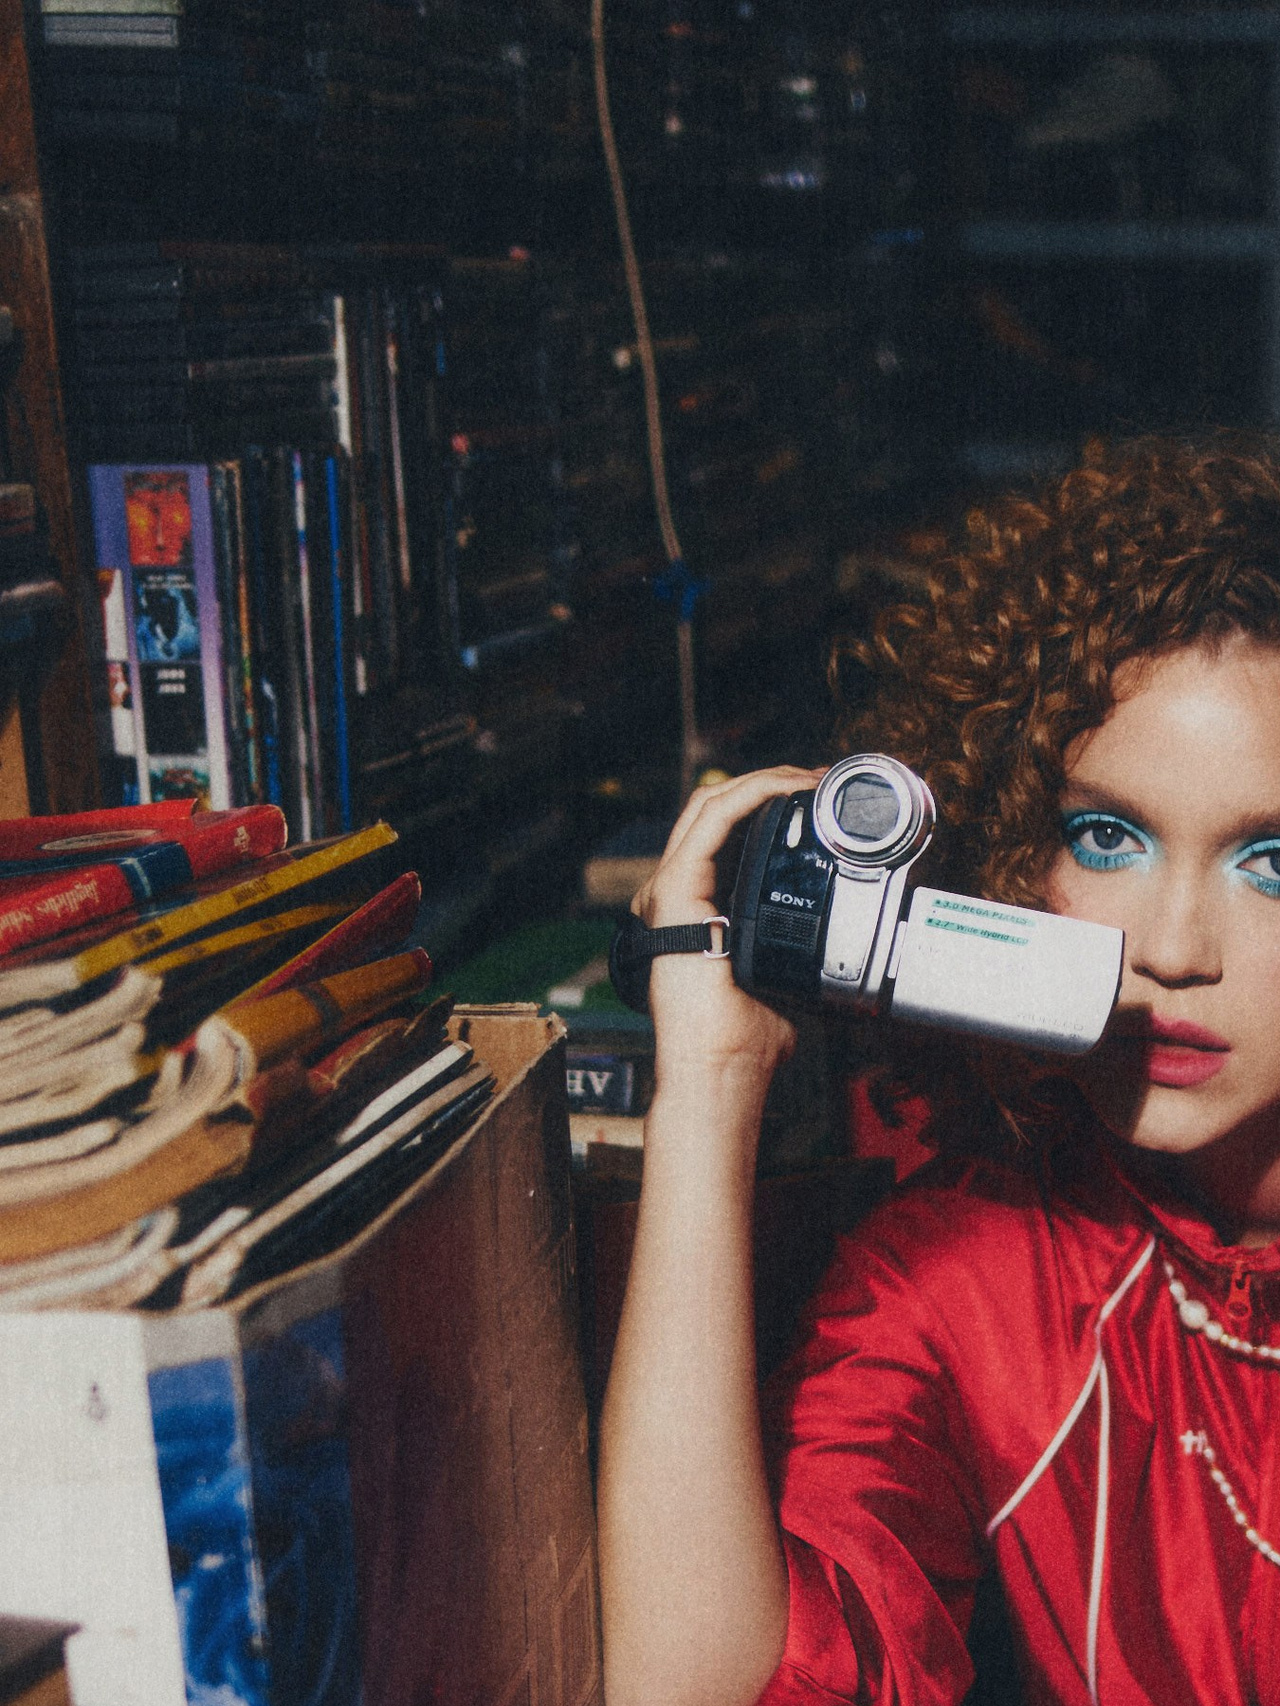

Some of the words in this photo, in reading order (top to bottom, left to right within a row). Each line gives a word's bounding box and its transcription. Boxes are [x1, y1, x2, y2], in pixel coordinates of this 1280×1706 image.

[770, 891, 816, 909] SONY
[942, 900, 959, 911] 3.0
[961, 904, 989, 918] MEGA
[992, 911, 1029, 926] PIXELS
[956, 923, 979, 934] Wide
[980, 928, 1010, 941] Hybrid
[1010, 935, 1029, 946] LCD
